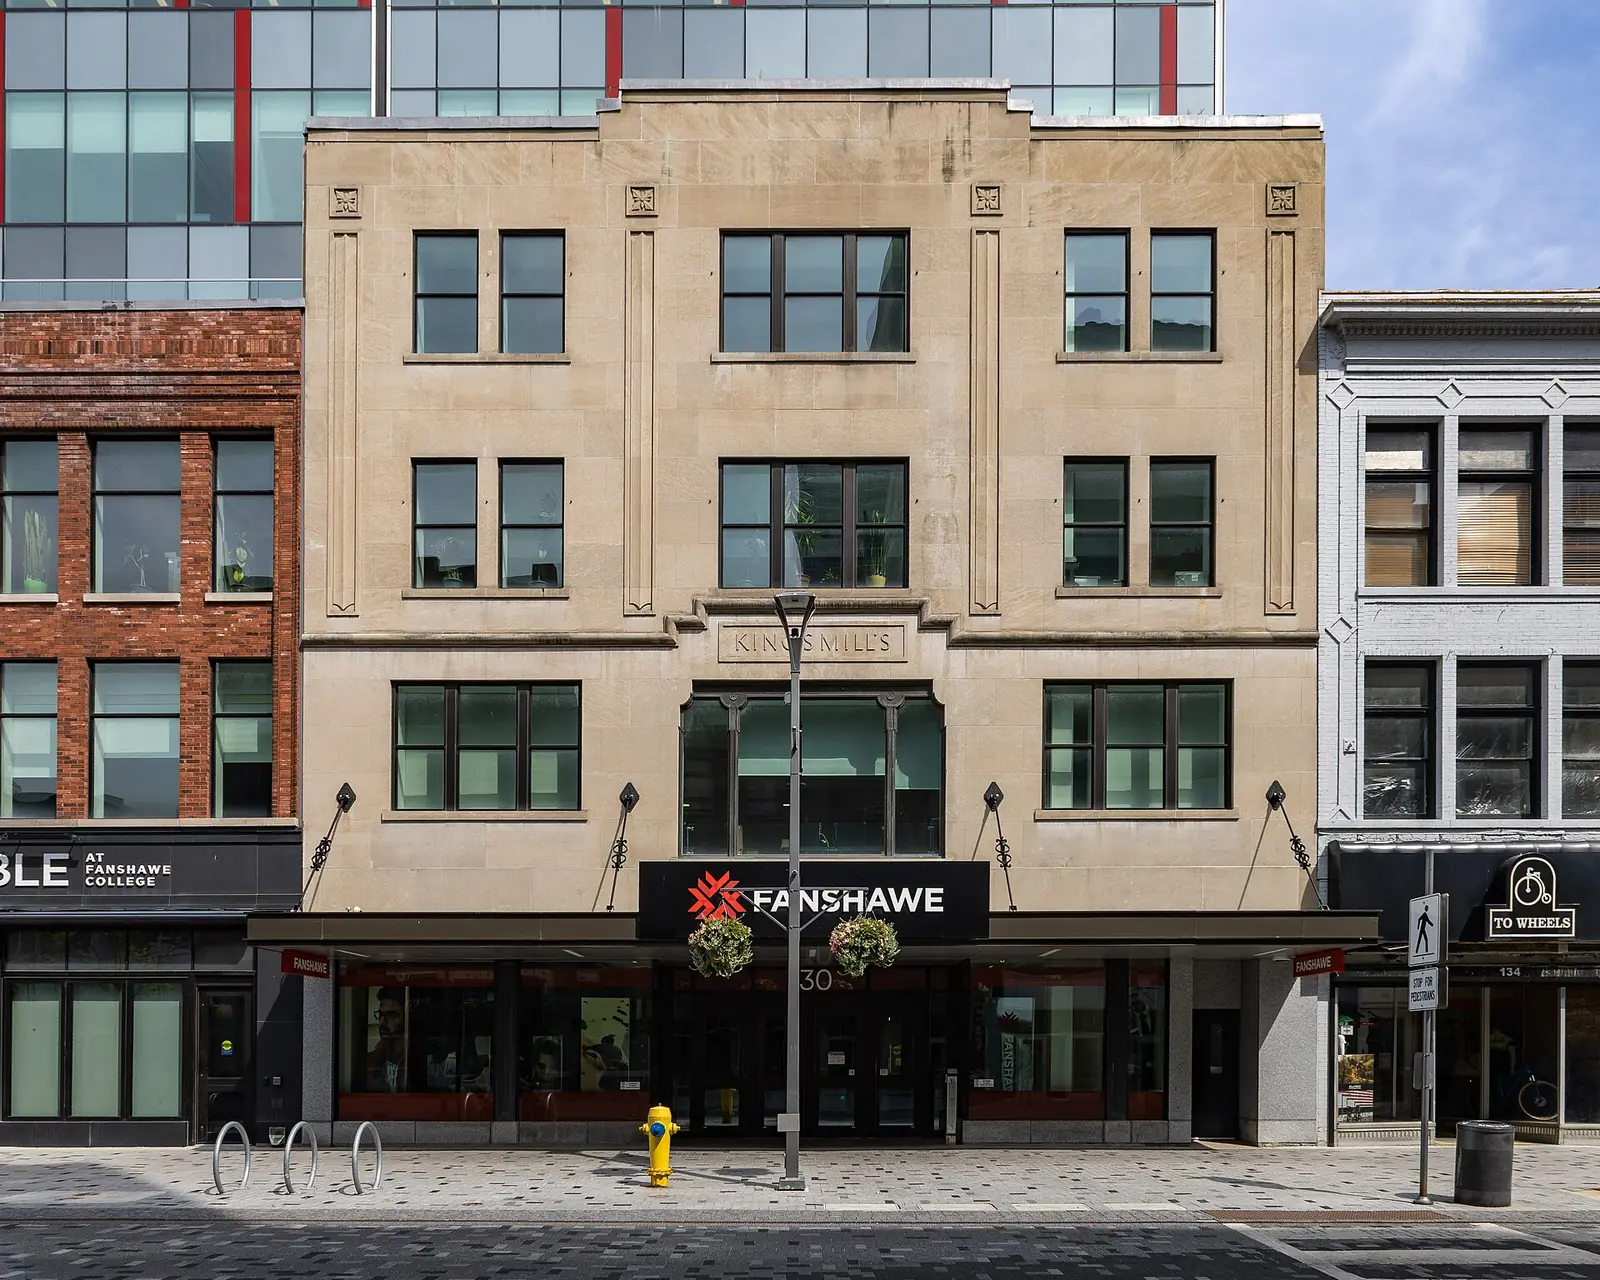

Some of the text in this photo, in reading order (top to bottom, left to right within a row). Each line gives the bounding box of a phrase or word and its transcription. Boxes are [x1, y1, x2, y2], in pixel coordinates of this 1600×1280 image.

[85, 852, 105, 863] AT
[85, 864, 172, 875] FANSHAWE
[85, 876, 156, 887] COLLEGE
[753, 887, 944, 913] FANSHAWE
[1494, 917, 1571, 929] TO WHEELS
[293, 957, 328, 974] FANSHAWE
[1295, 956, 1332, 973] FANSHAWE
[1499, 967, 1521, 977] 134
[1413, 976, 1433, 988] STOP FOR
[1410, 990, 1435, 1002] PEDESTRIANS
